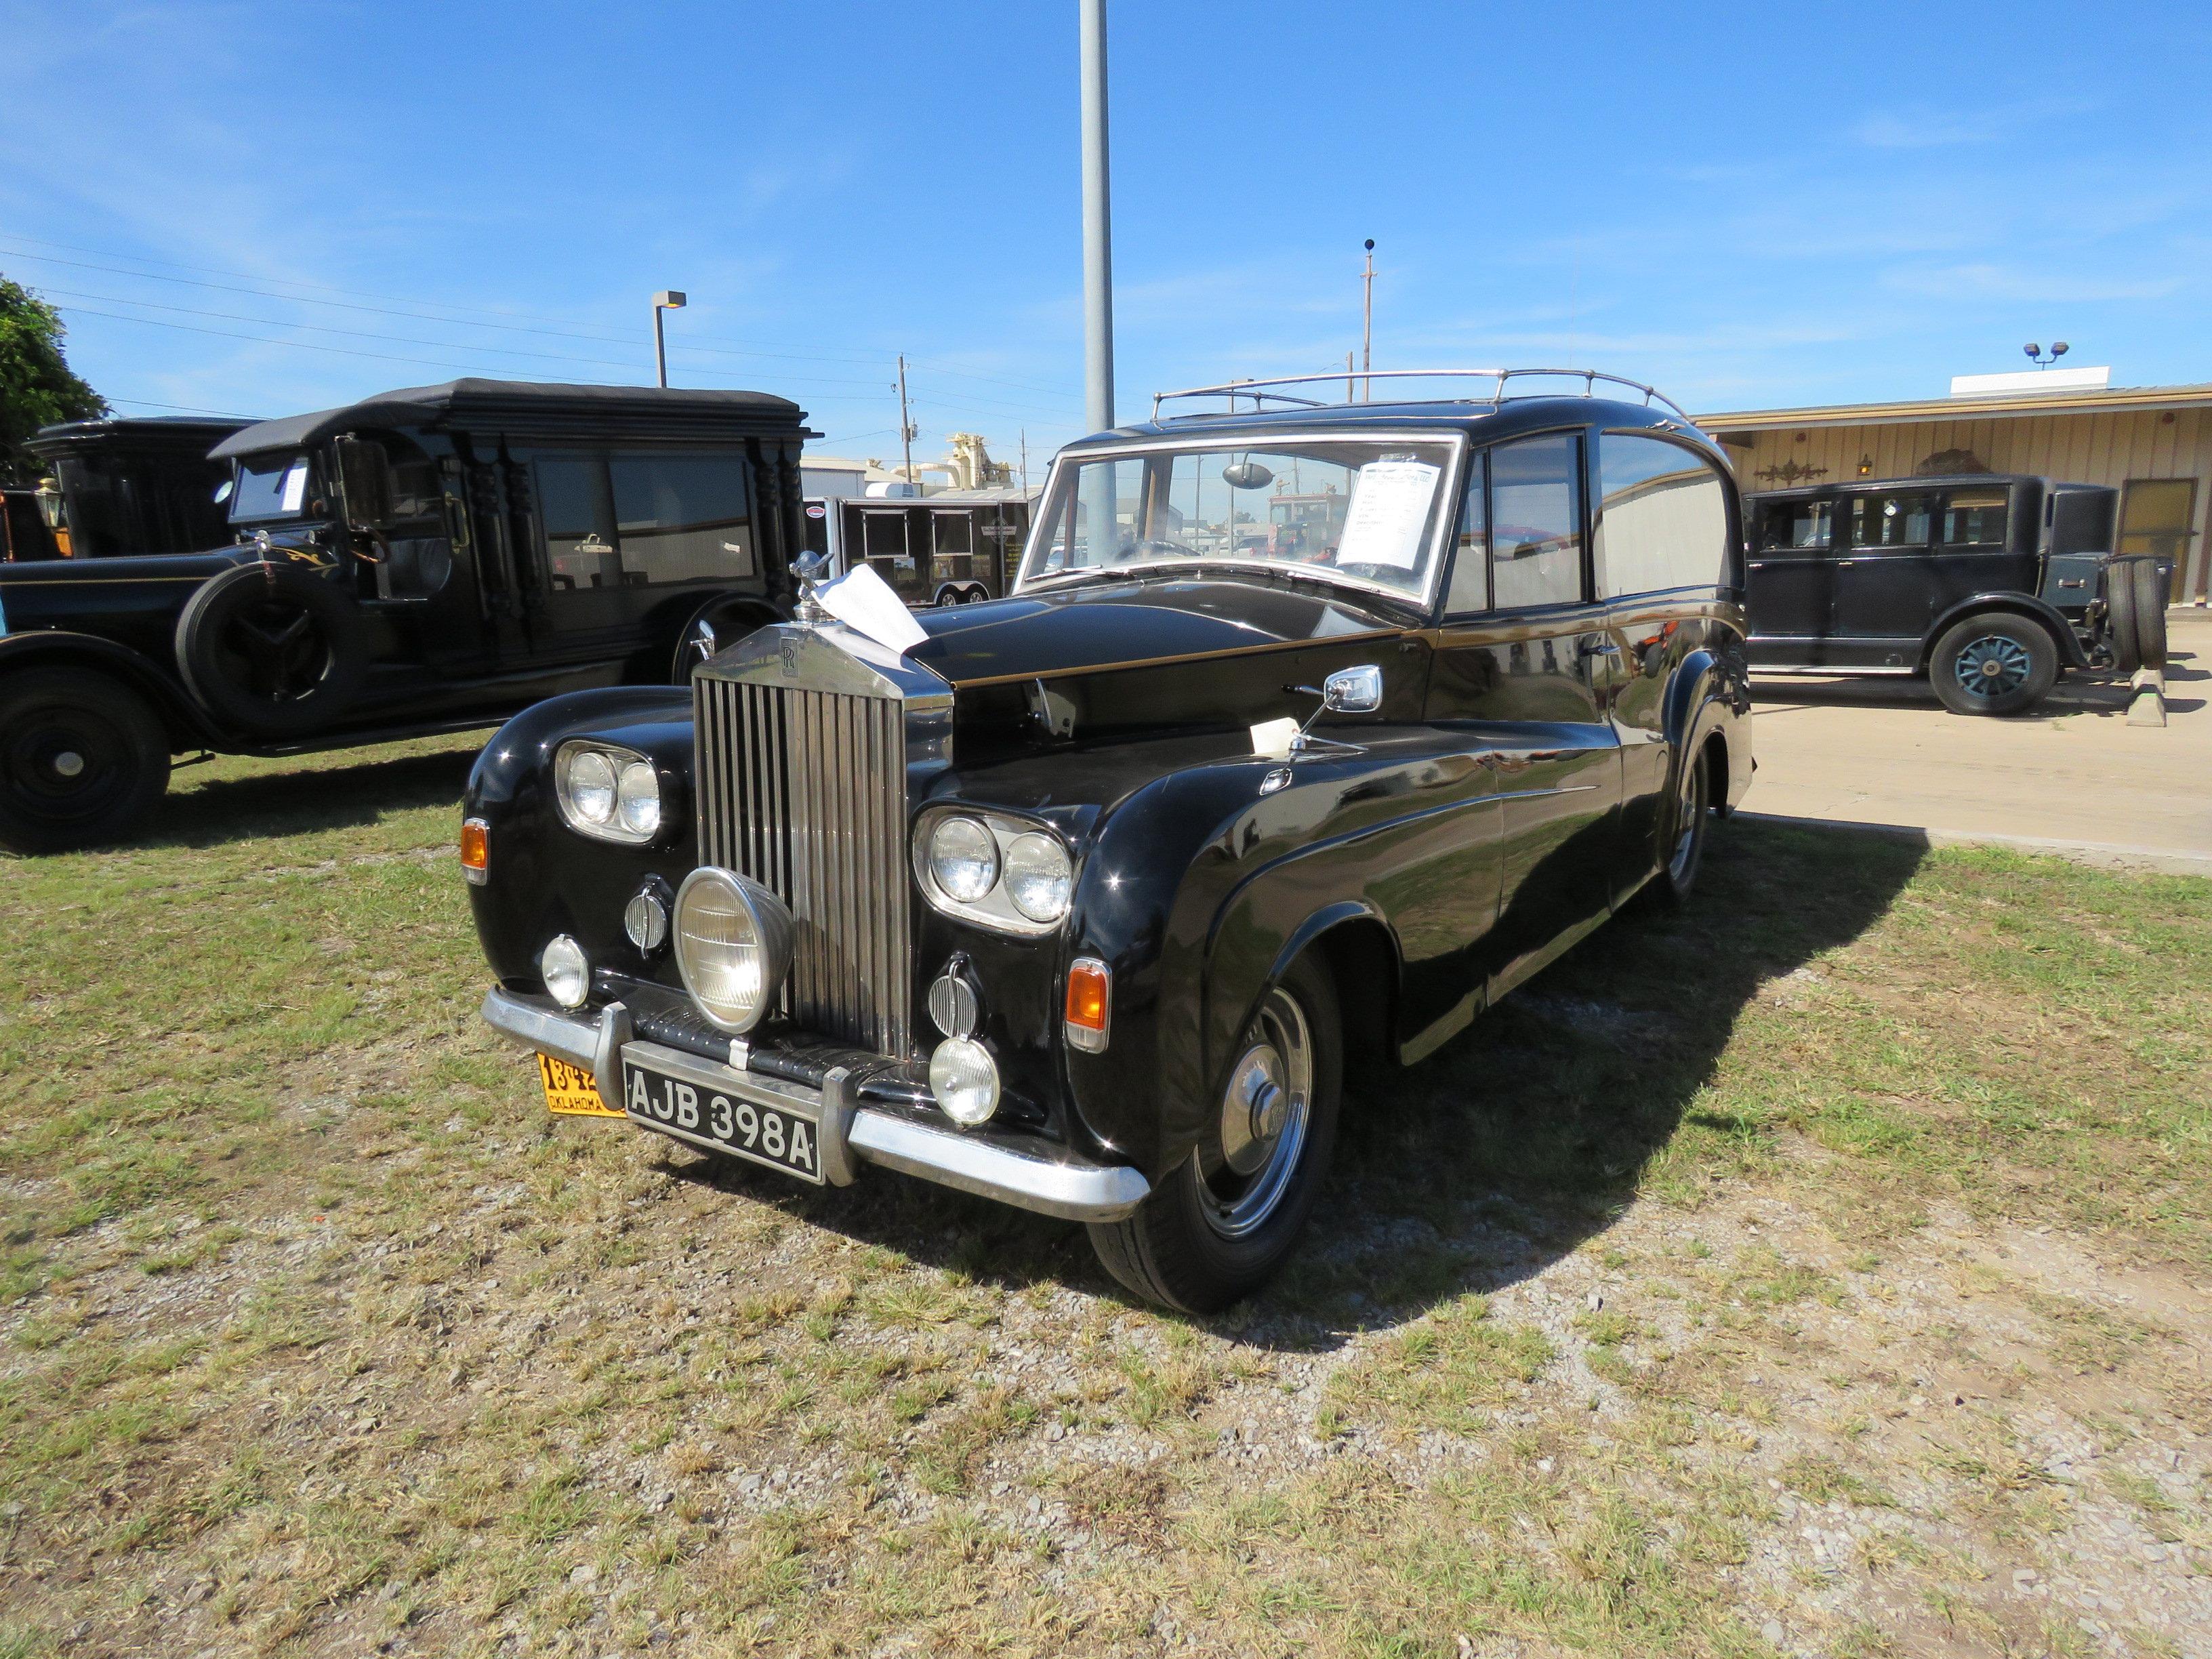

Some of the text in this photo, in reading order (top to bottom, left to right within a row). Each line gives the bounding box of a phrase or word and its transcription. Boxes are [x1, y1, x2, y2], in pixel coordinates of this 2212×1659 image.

[549, 1095, 602, 1111] OKLAHOMA
[631, 1069, 813, 1170] AJB 398A
